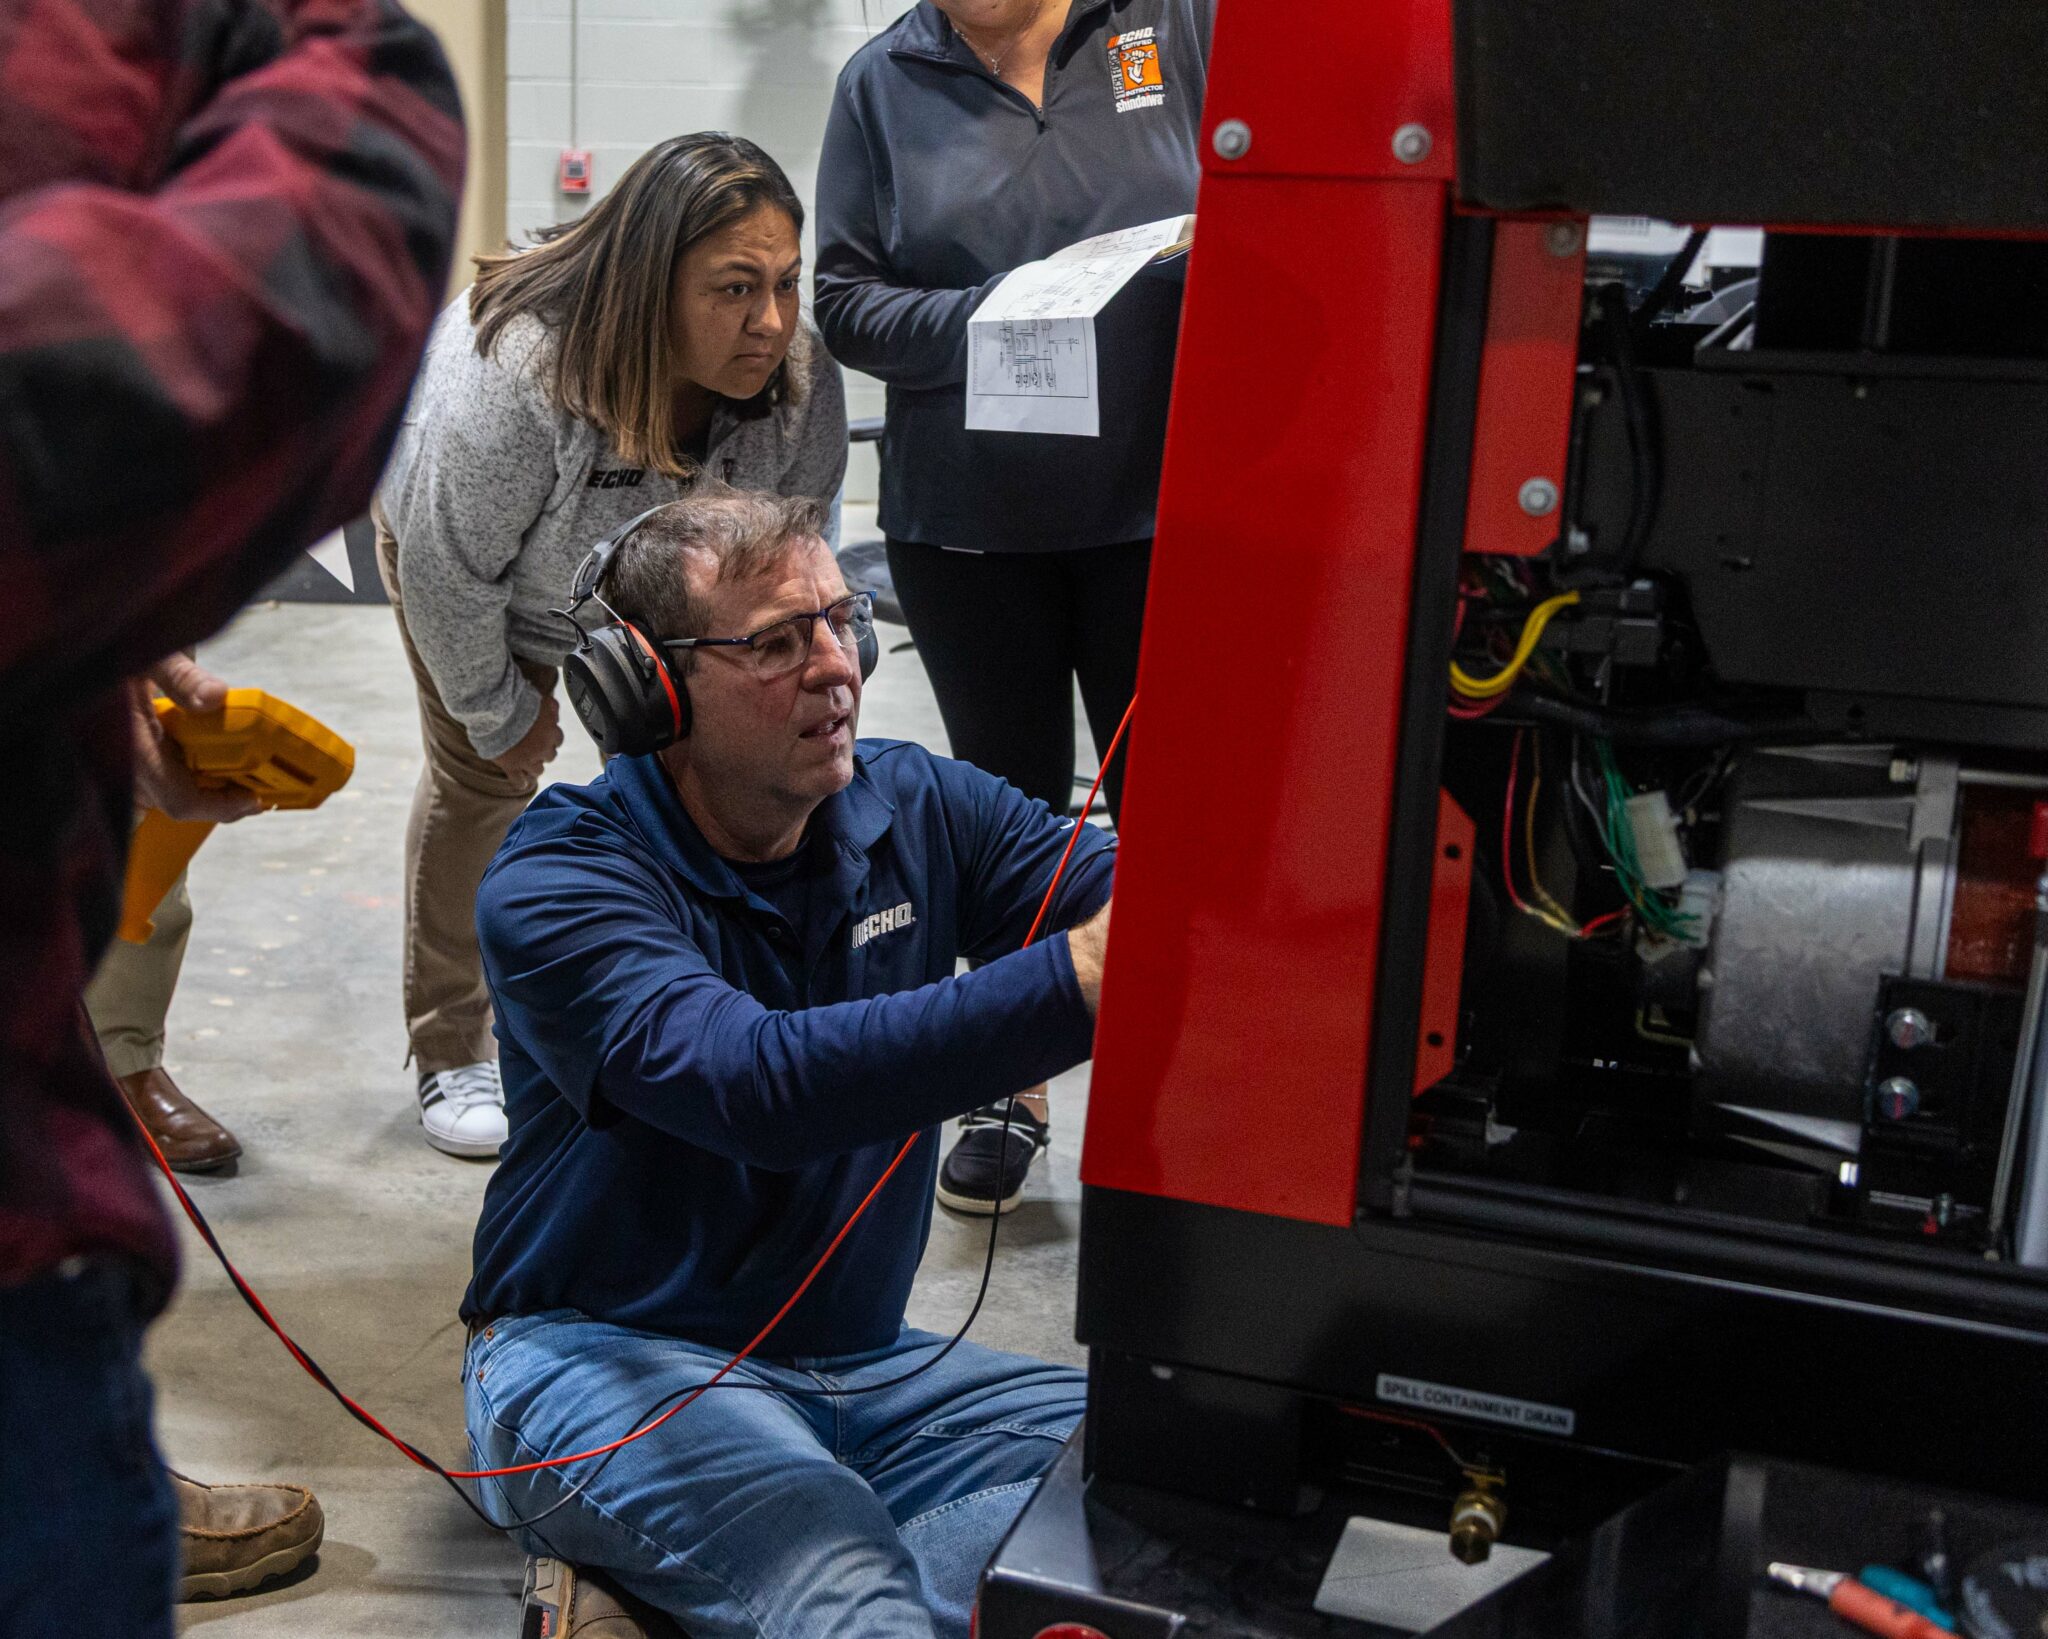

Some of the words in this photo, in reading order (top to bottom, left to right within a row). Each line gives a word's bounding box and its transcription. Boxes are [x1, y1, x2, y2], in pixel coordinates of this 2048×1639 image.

[1117, 27, 1154, 45] ECHO
[1116, 93, 1164, 113] shindaiwa
[586, 469, 646, 489] ECHO
[860, 902, 912, 944] ECHO
[1383, 1382, 1419, 1399] SPILL
[1424, 1390, 1521, 1418] CONTAINMENT
[1524, 1409, 1568, 1427] DRAIN
